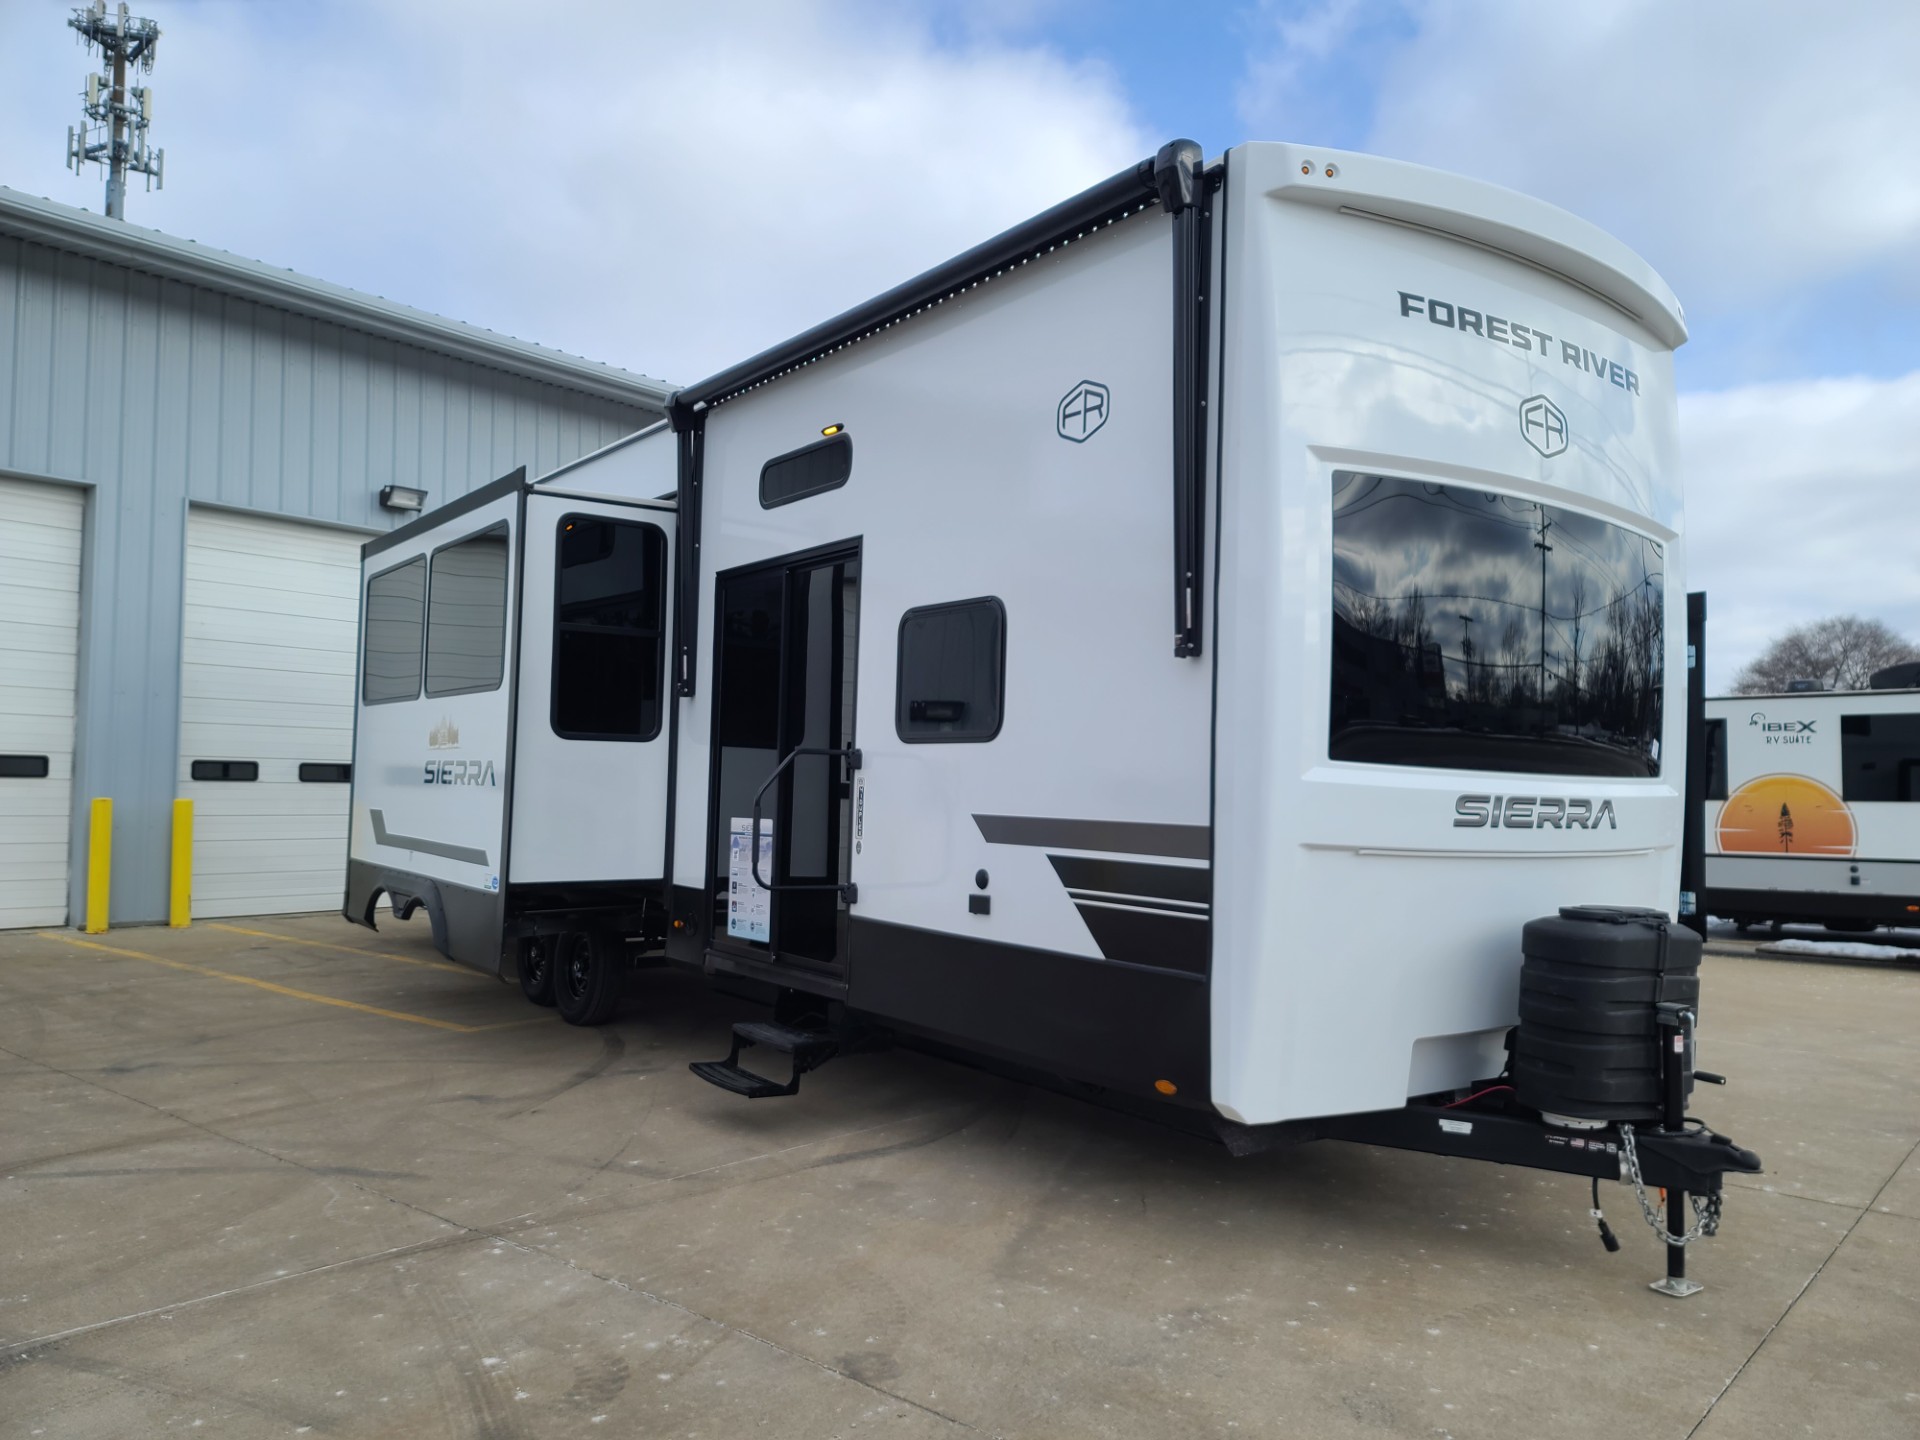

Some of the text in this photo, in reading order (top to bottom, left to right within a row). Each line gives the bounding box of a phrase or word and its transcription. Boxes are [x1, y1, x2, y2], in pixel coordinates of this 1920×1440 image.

[1397, 290, 1641, 397] FOREST RIVER
[1762, 720, 1817, 733] IBEX
[1766, 735, 1780, 744] RV
[424, 760, 496, 787] SIERRA
[1453, 794, 1617, 830] SIERRA
